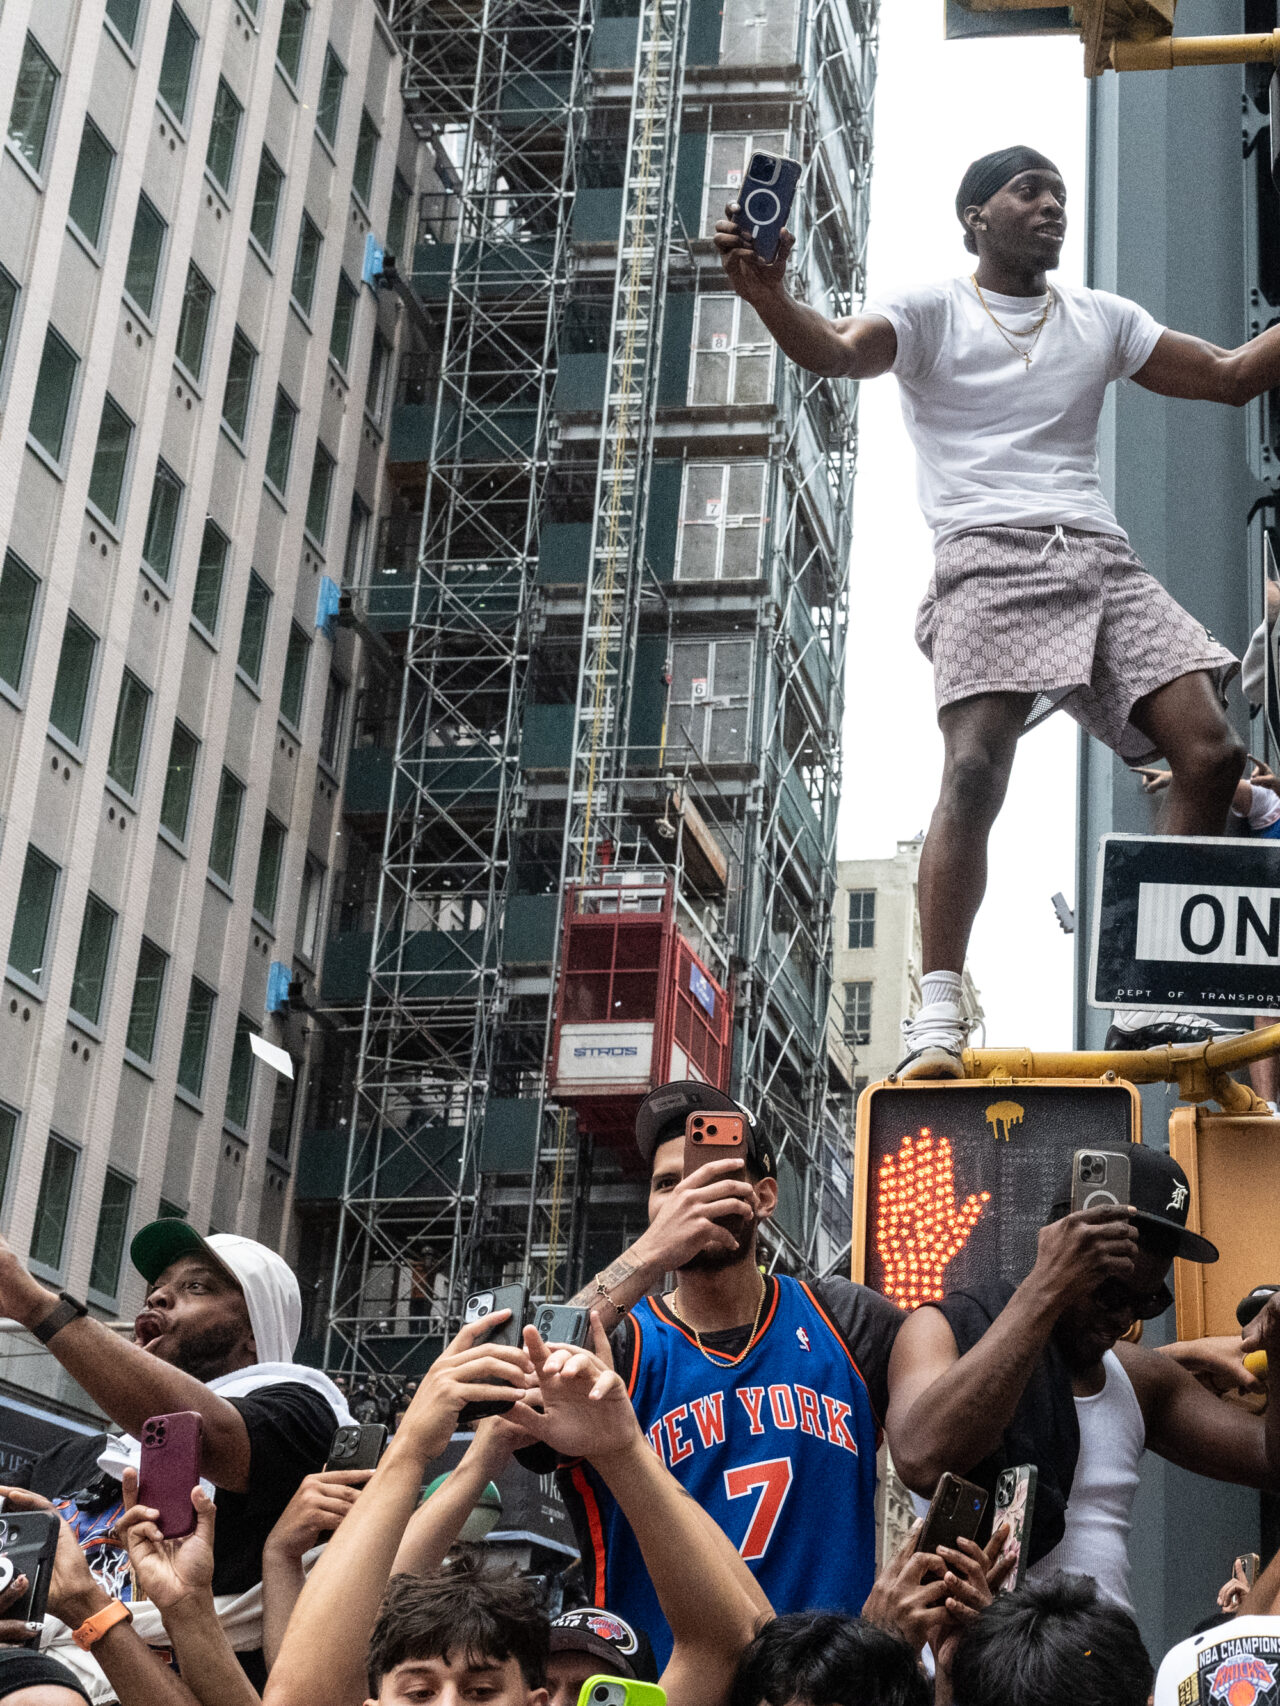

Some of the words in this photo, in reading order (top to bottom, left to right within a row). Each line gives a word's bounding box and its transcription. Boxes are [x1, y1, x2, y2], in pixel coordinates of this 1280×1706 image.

[1117, 989, 1152, 997] DEPT
[573, 1047, 638, 1058] STROS
[736, 1383, 859, 1457] YORK
[723, 1456, 794, 1561] 7
[1199, 1648, 1219, 1669] NBA
[1213, 1660, 1273, 1692] KNICKS
